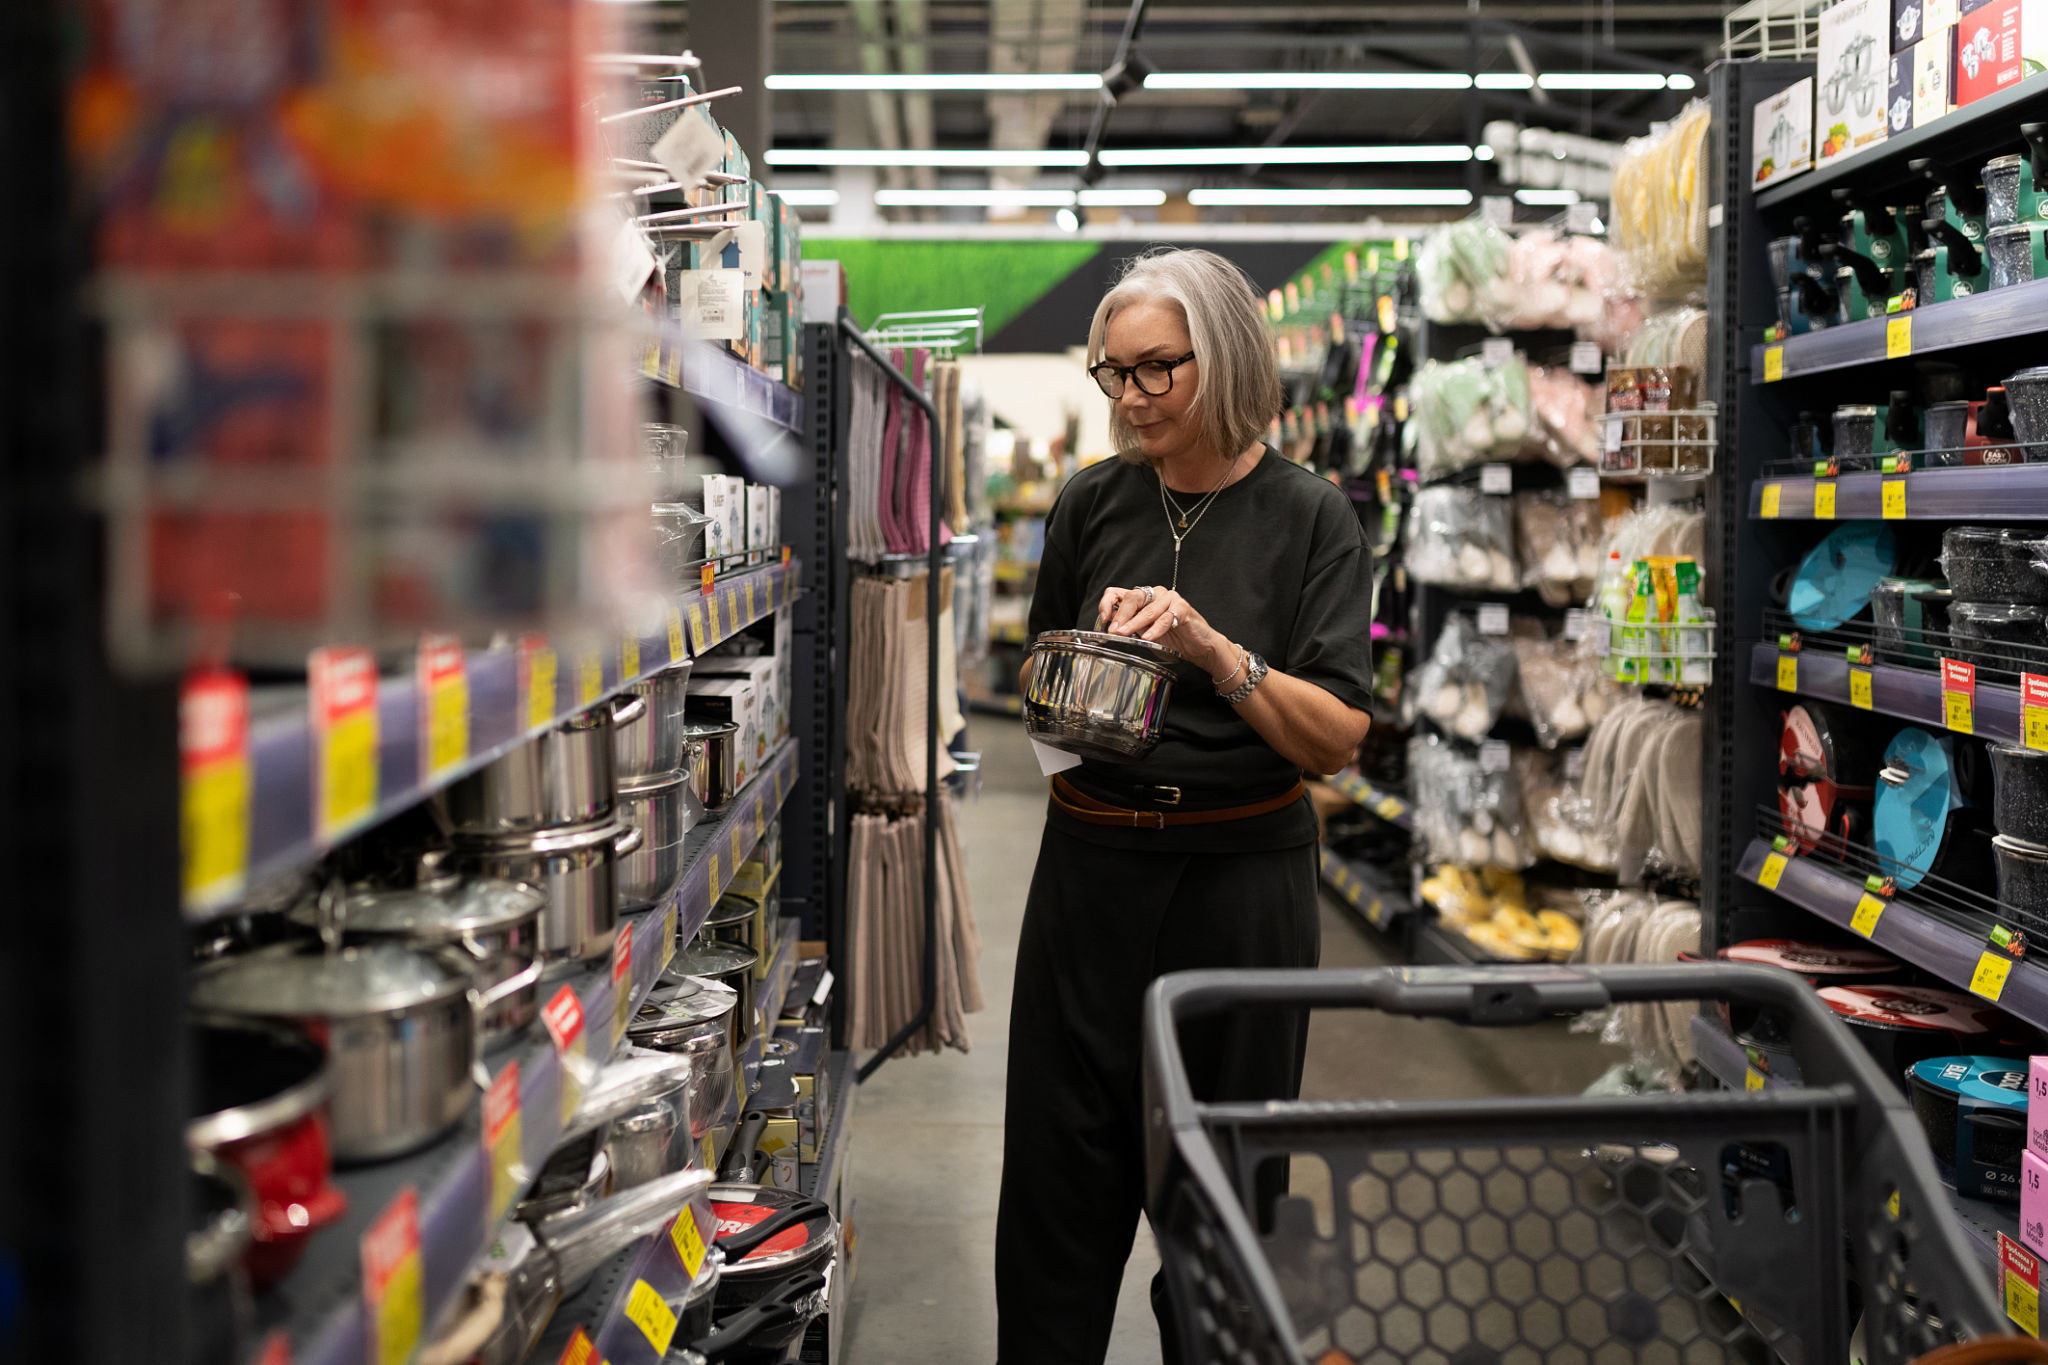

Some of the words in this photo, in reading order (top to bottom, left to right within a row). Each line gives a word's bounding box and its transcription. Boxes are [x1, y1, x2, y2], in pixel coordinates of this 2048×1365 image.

[2035, 1077, 2047, 1097] 1,5
[2000, 1173, 2015, 1183] 26
[2028, 1169, 2040, 1190] 1,5
